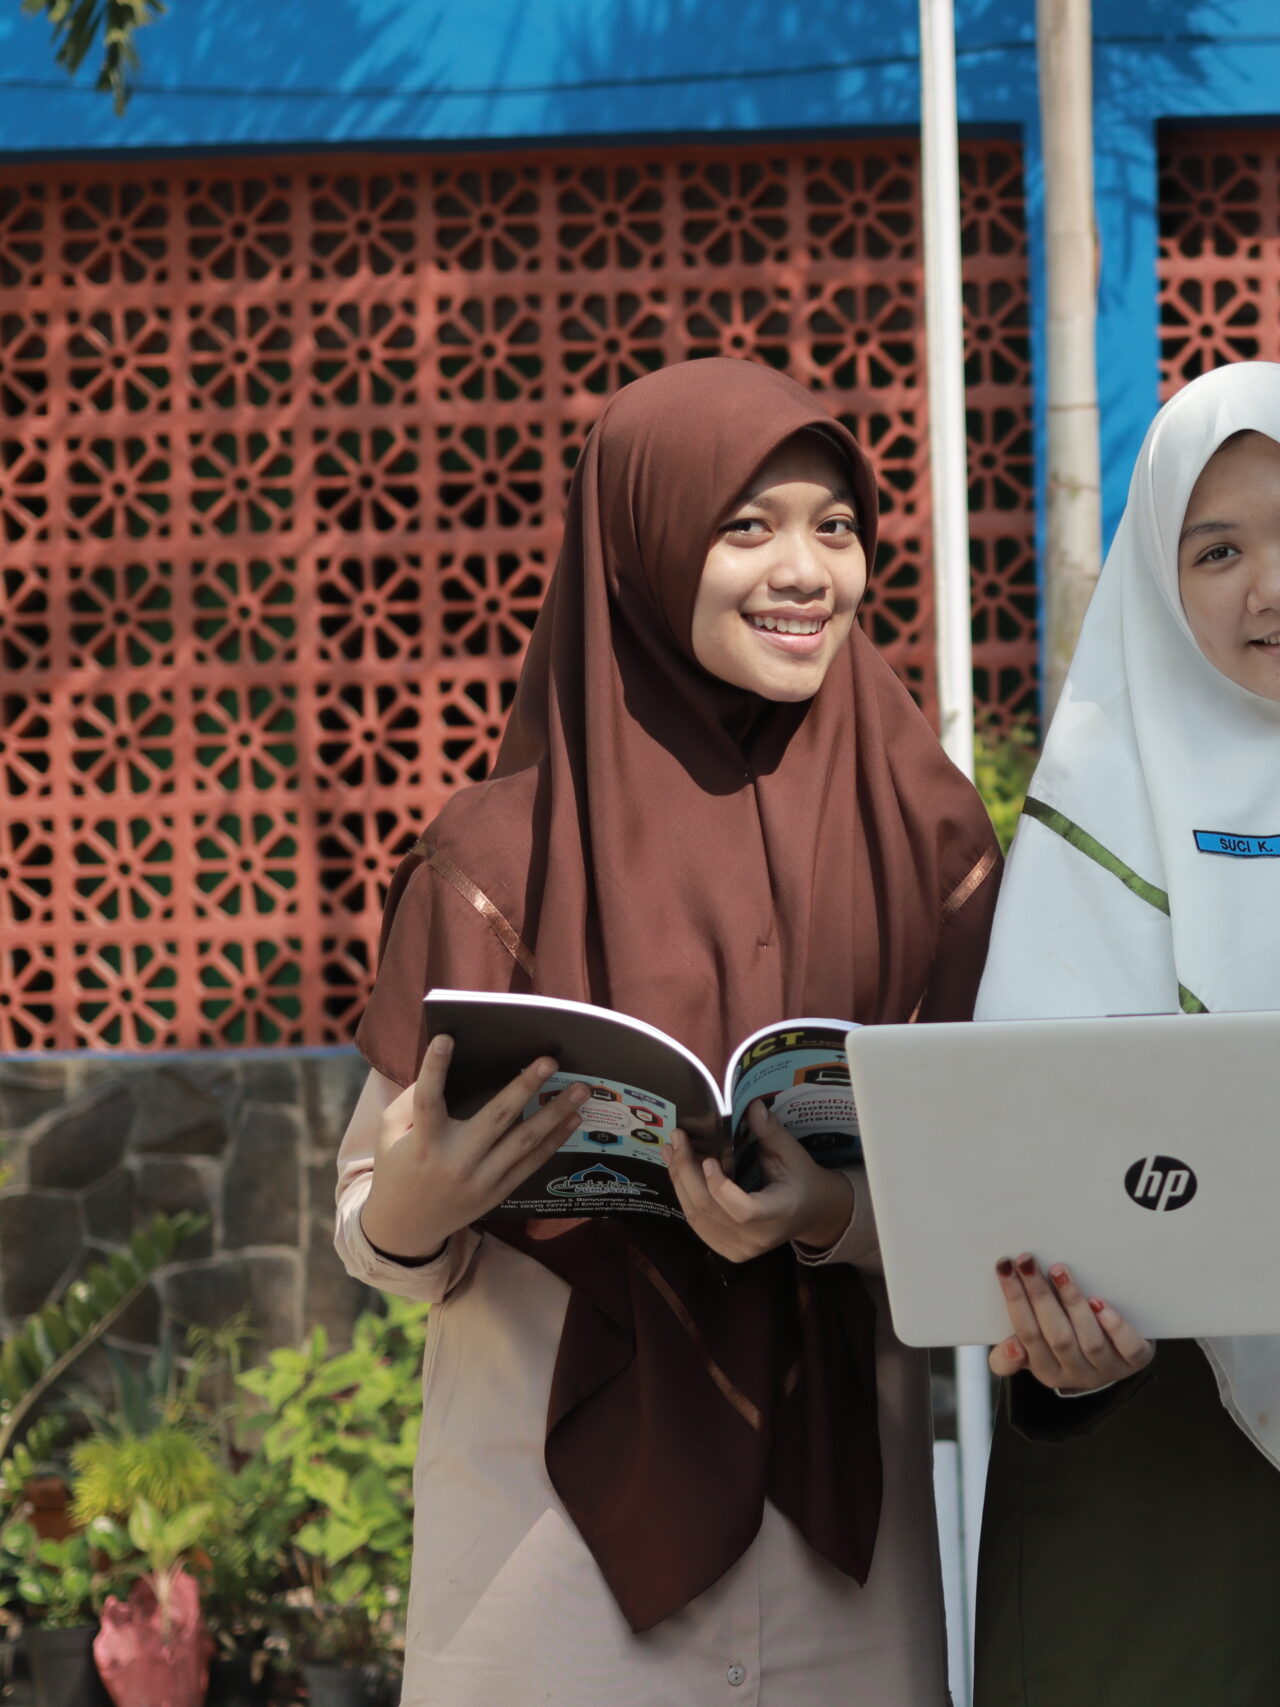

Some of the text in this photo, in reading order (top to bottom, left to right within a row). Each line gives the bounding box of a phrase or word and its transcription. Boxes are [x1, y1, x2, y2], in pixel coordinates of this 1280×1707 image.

[1219, 837, 1273, 852] SUCI K.
[743, 1031, 805, 1071] ICT
[787, 1105, 856, 1115] Photosh
[783, 1116, 858, 1128] Construc
[1134, 1155, 1190, 1211] hp
